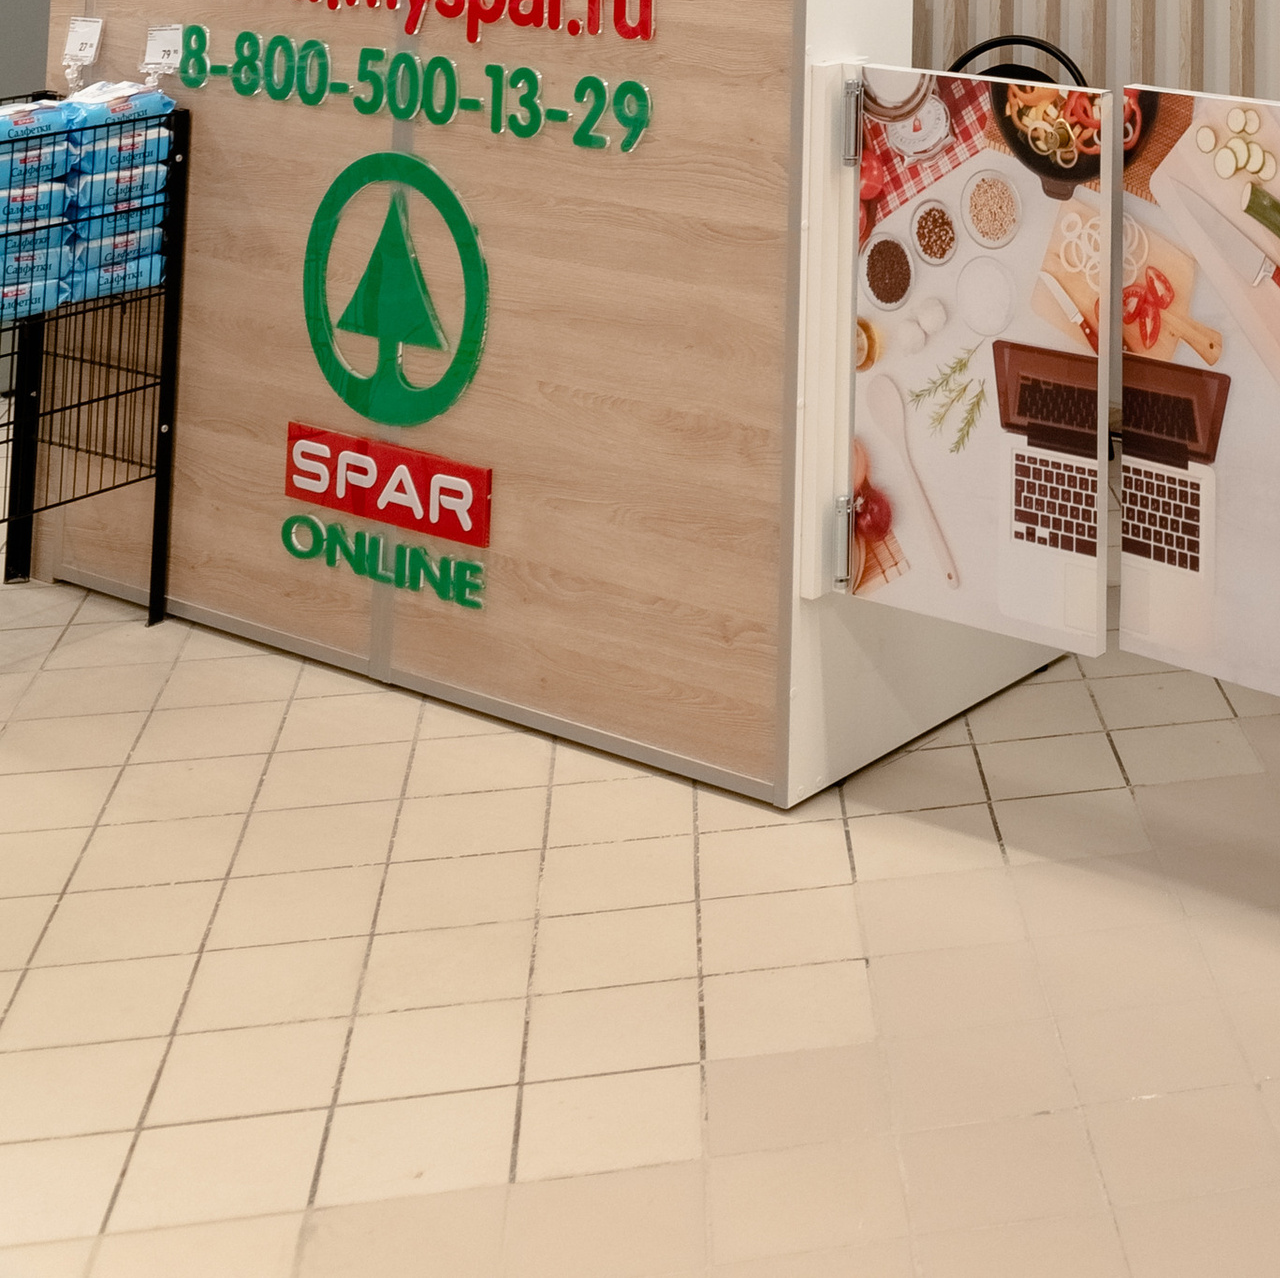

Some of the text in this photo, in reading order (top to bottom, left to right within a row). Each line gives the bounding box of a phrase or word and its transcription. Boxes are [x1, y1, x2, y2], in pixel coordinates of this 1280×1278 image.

[8, 124, 52, 138] Салфетки
[178, 24, 654, 154] 8-800-500-13-29
[290, 439, 476, 533] SPAR
[281, 512, 486, 610] ONLINE
